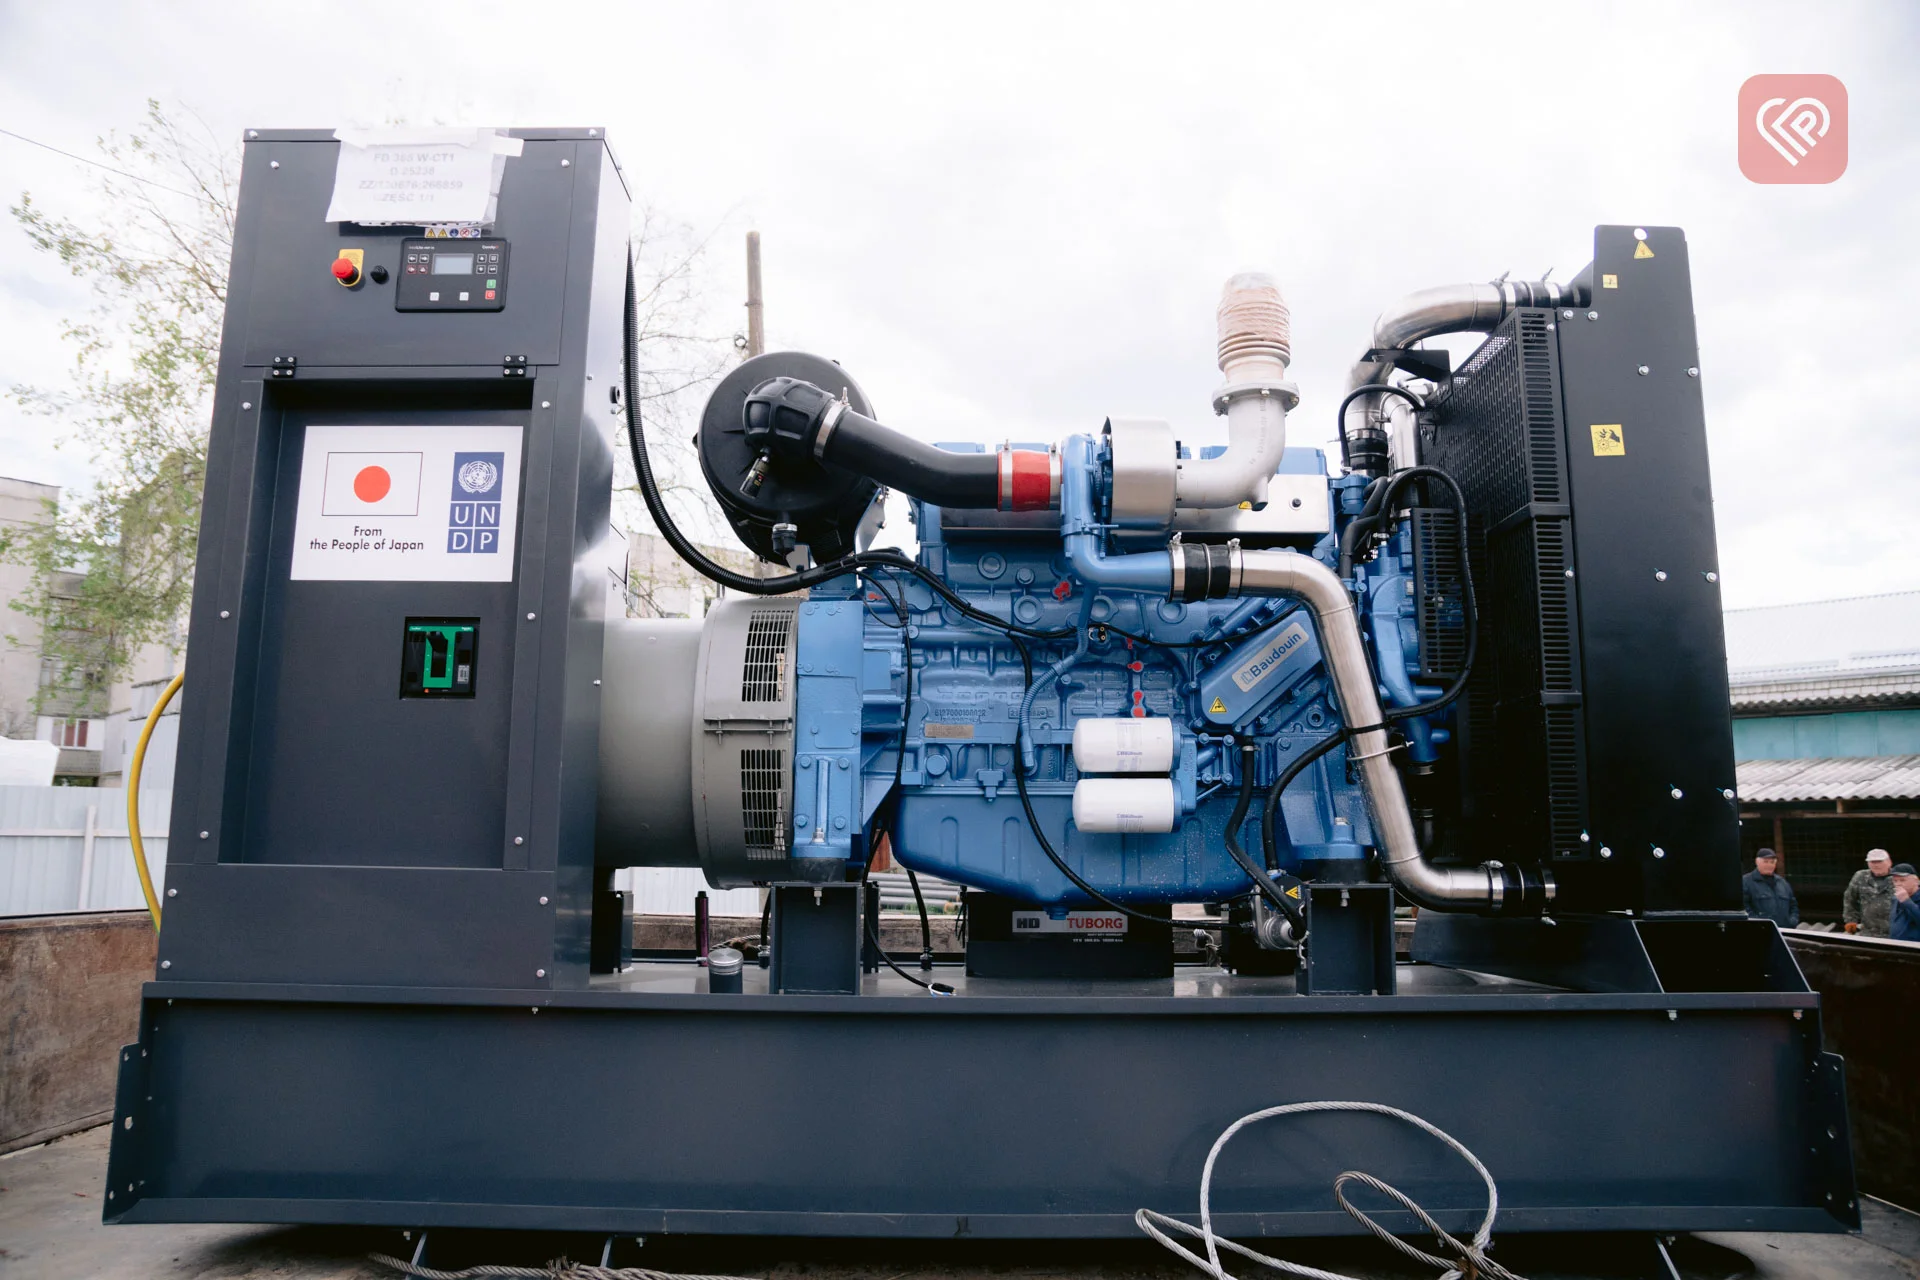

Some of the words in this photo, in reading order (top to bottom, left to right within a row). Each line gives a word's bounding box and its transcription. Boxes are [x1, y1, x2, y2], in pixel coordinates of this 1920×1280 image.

[353, 525, 382, 537] From
[310, 539, 328, 550] the
[331, 539, 370, 553] People
[373, 539, 387, 550] of
[388, 539, 424, 553] Japan
[1249, 632, 1303, 678] Baudouin
[1016, 918, 1041, 929] HD
[1066, 917, 1123, 929] TUBORG
